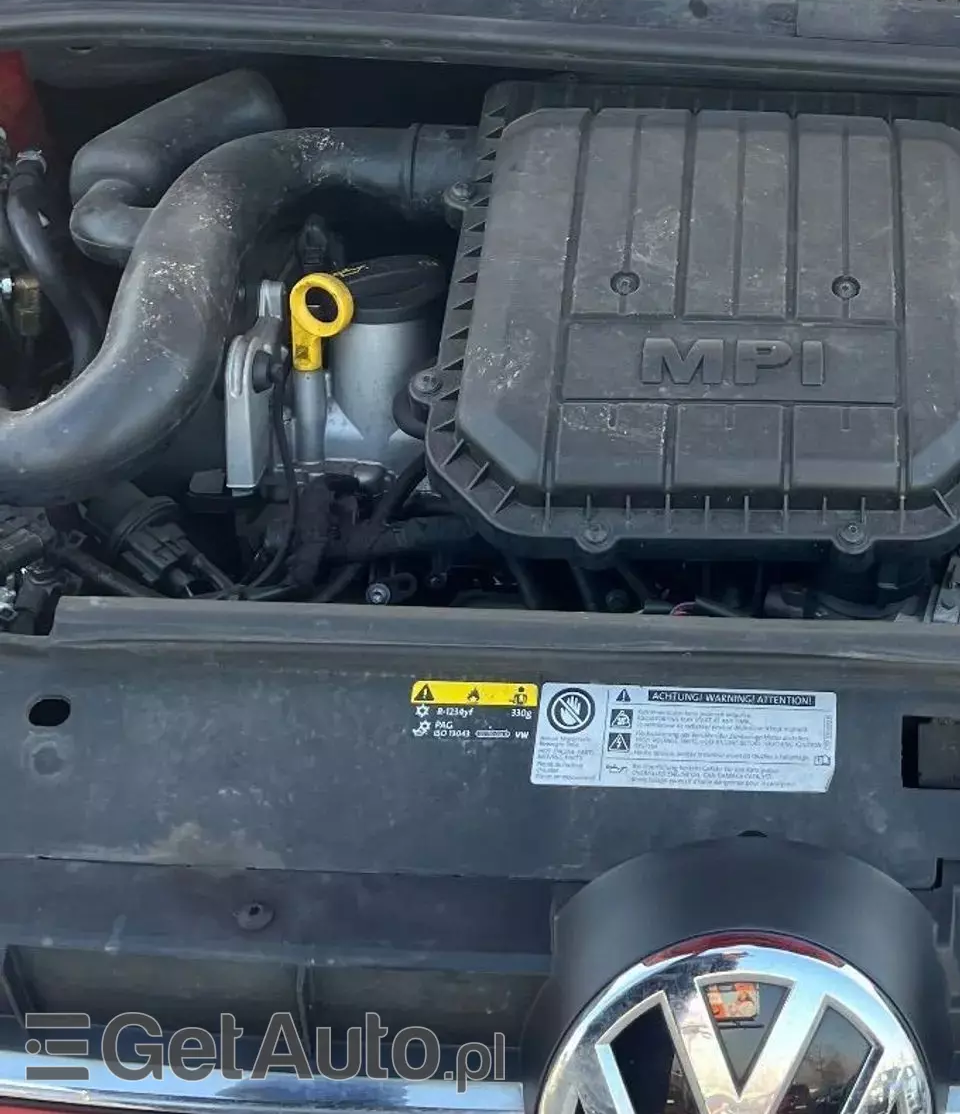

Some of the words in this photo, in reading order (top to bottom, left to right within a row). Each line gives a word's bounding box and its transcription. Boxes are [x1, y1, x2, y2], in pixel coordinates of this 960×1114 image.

[640, 337, 826, 387] MPI
[652, 692, 702, 703] ACHTUNG!
[705, 693, 755, 704] WARNING!
[757, 695, 813, 706] ATTENTION!
[511, 708, 533, 719] 330g
[434, 721, 453, 729] PAG
[433, 730, 448, 738] ISO
